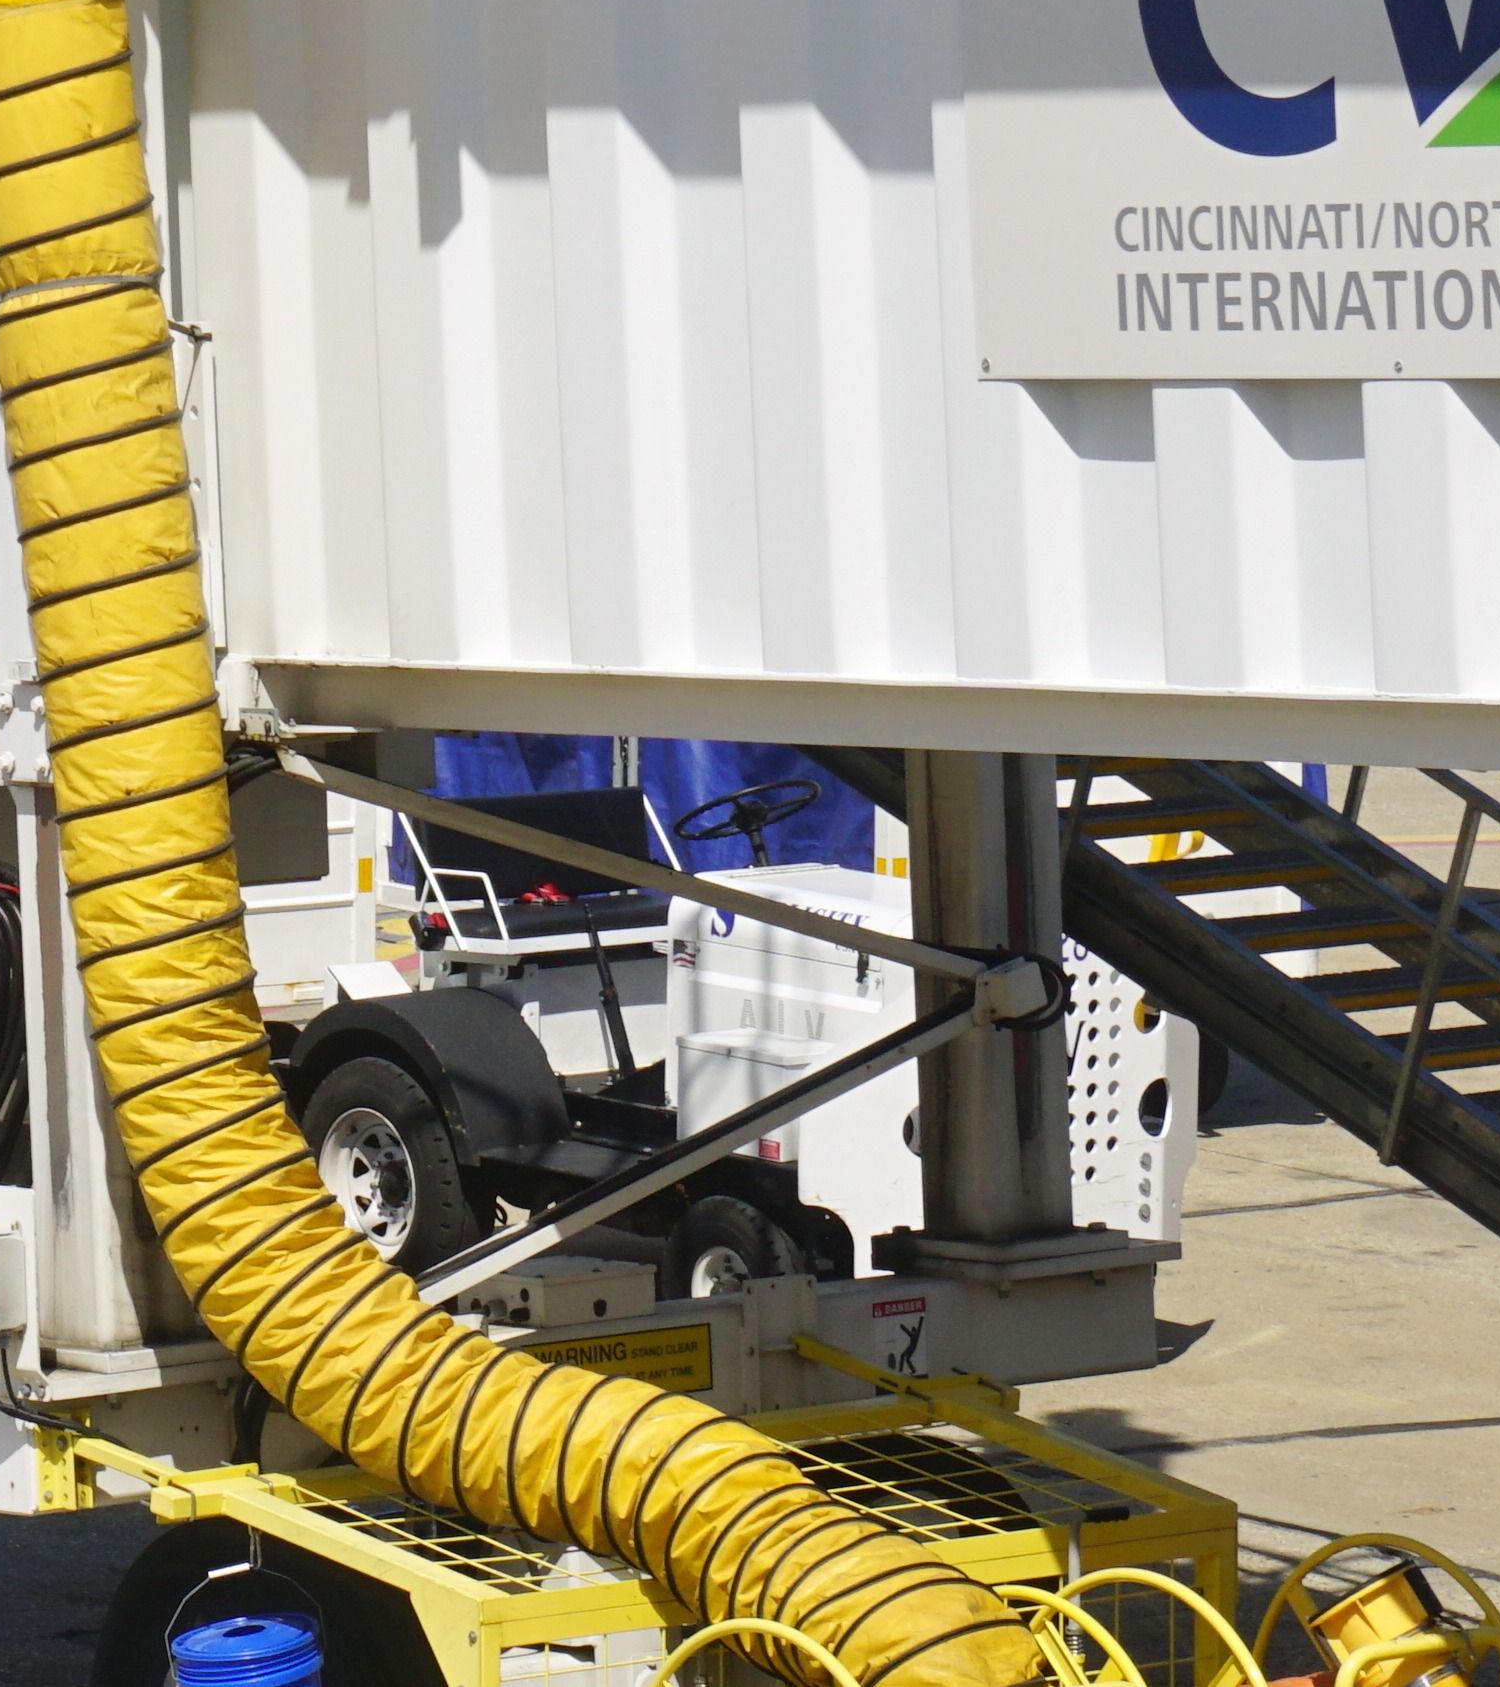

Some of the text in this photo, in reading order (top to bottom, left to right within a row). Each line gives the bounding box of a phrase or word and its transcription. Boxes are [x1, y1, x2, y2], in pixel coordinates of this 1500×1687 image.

[534, 1340, 698, 1366] WARNING STAND CLEAR
[670, 1364, 695, 1377] TIME
